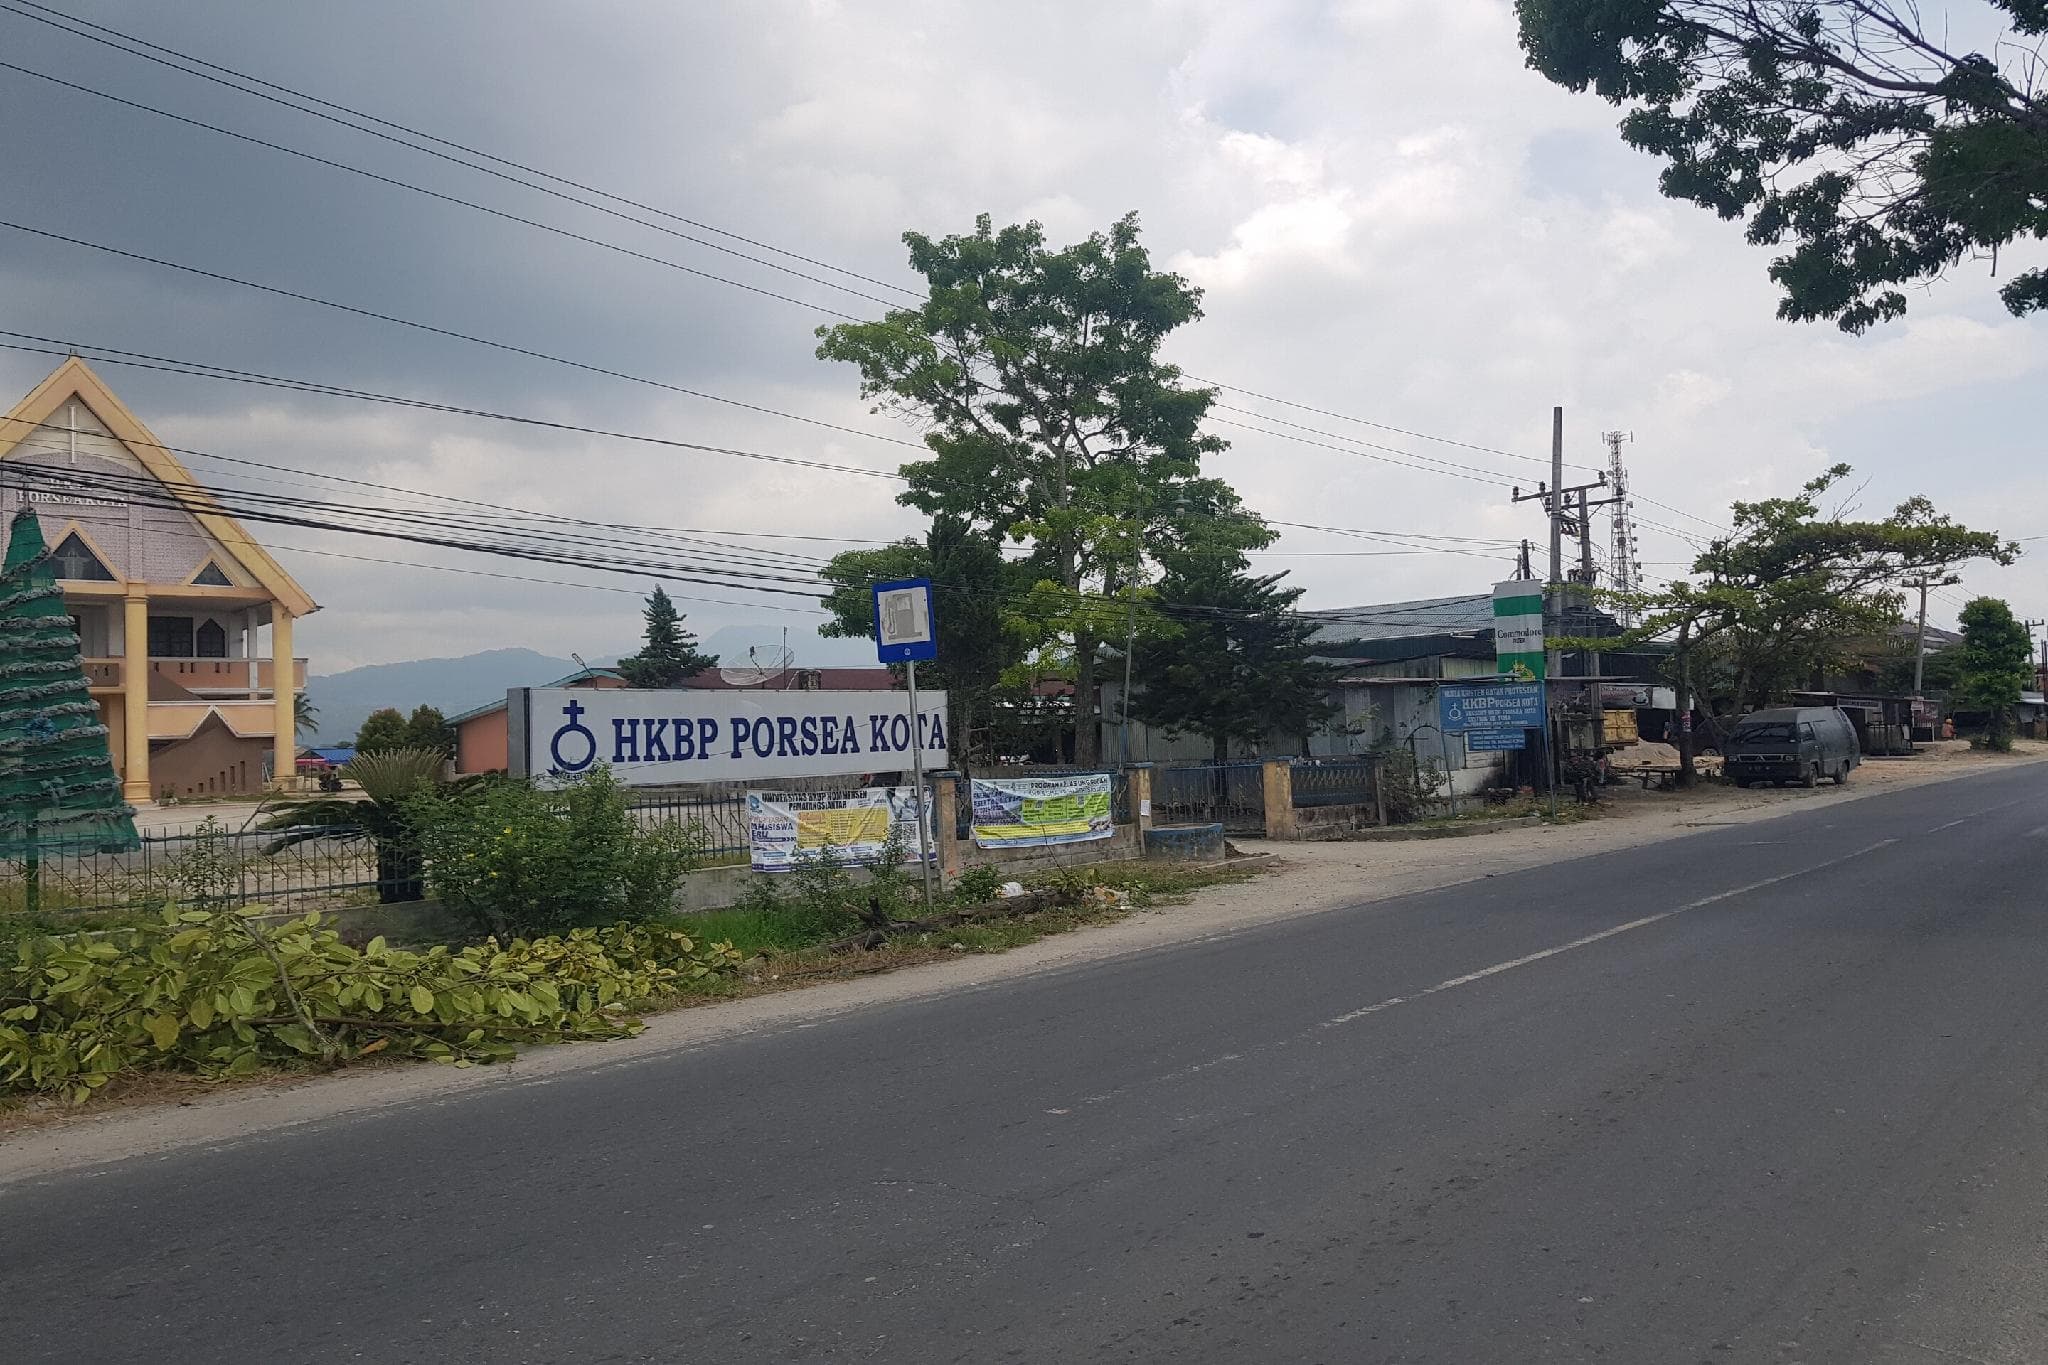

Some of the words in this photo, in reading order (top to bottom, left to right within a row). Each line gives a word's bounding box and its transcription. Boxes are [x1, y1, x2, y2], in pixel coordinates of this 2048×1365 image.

[1497, 627, 1542, 639] Commodore
[1462, 696, 1495, 710] HKBP
[612, 718, 719, 763] HKBP
[730, 715, 861, 759] PORSEA
[869, 713, 947, 752] KOTA
